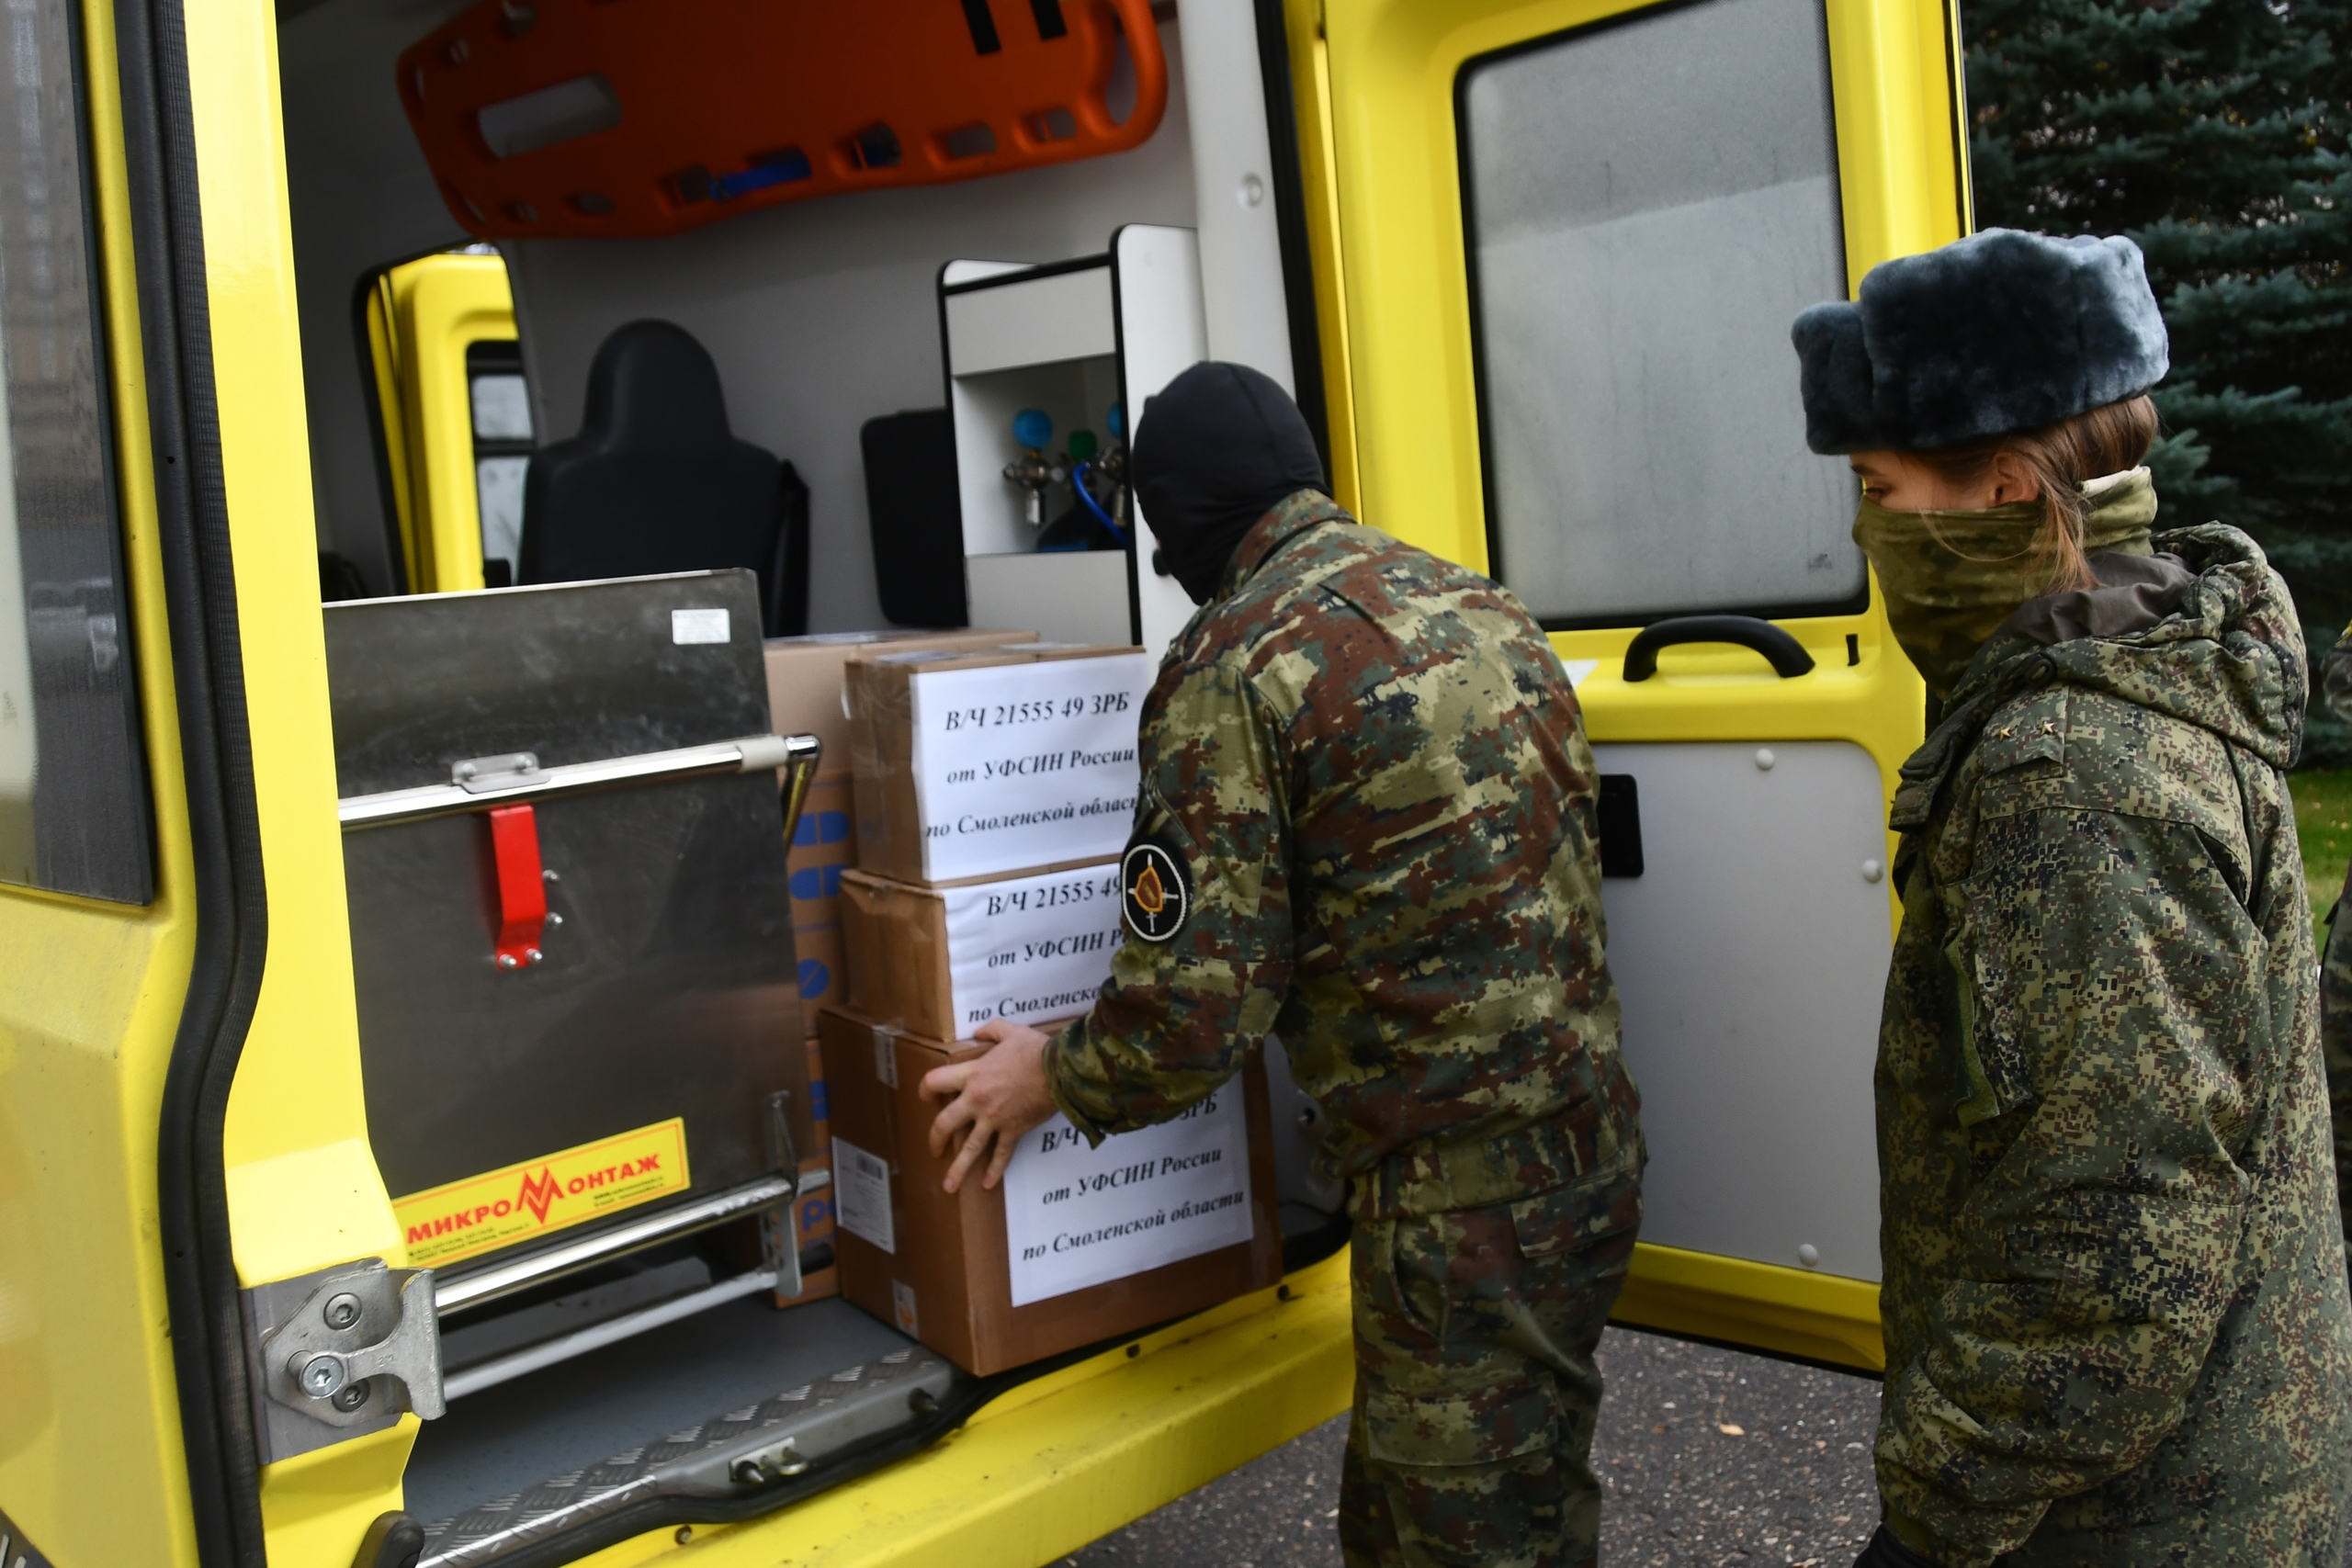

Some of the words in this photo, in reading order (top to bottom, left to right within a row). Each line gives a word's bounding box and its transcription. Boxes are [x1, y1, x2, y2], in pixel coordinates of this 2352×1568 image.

[945, 709, 986, 731] В/Ч
[994, 700, 1054, 726] 21555
[1060, 695, 1084, 716] 49
[1091, 692, 1130, 715] ЗРБ
[946, 769, 976, 784] от
[984, 751, 1064, 779] УФСИН
[1069, 747, 1135, 768] России
[926, 823, 950, 838] по
[957, 804, 1075, 835] Смоленской
[987, 890, 1027, 916] В/Ч
[1035, 879, 1094, 908] 21555
[988, 953, 1016, 968] от
[1023, 931, 1104, 962] УФСИН
[968, 1008, 991, 1023] по
[1041, 1126, 1080, 1154] В/Ч
[1043, 1188, 1070, 1205] от
[1078, 1161, 1155, 1196] УФСИН
[1161, 1148, 1222, 1176] России
[1023, 1243, 1046, 1261] по
[1053, 1209, 1167, 1253] Смоленской
[1170, 1190, 1245, 1224] области
